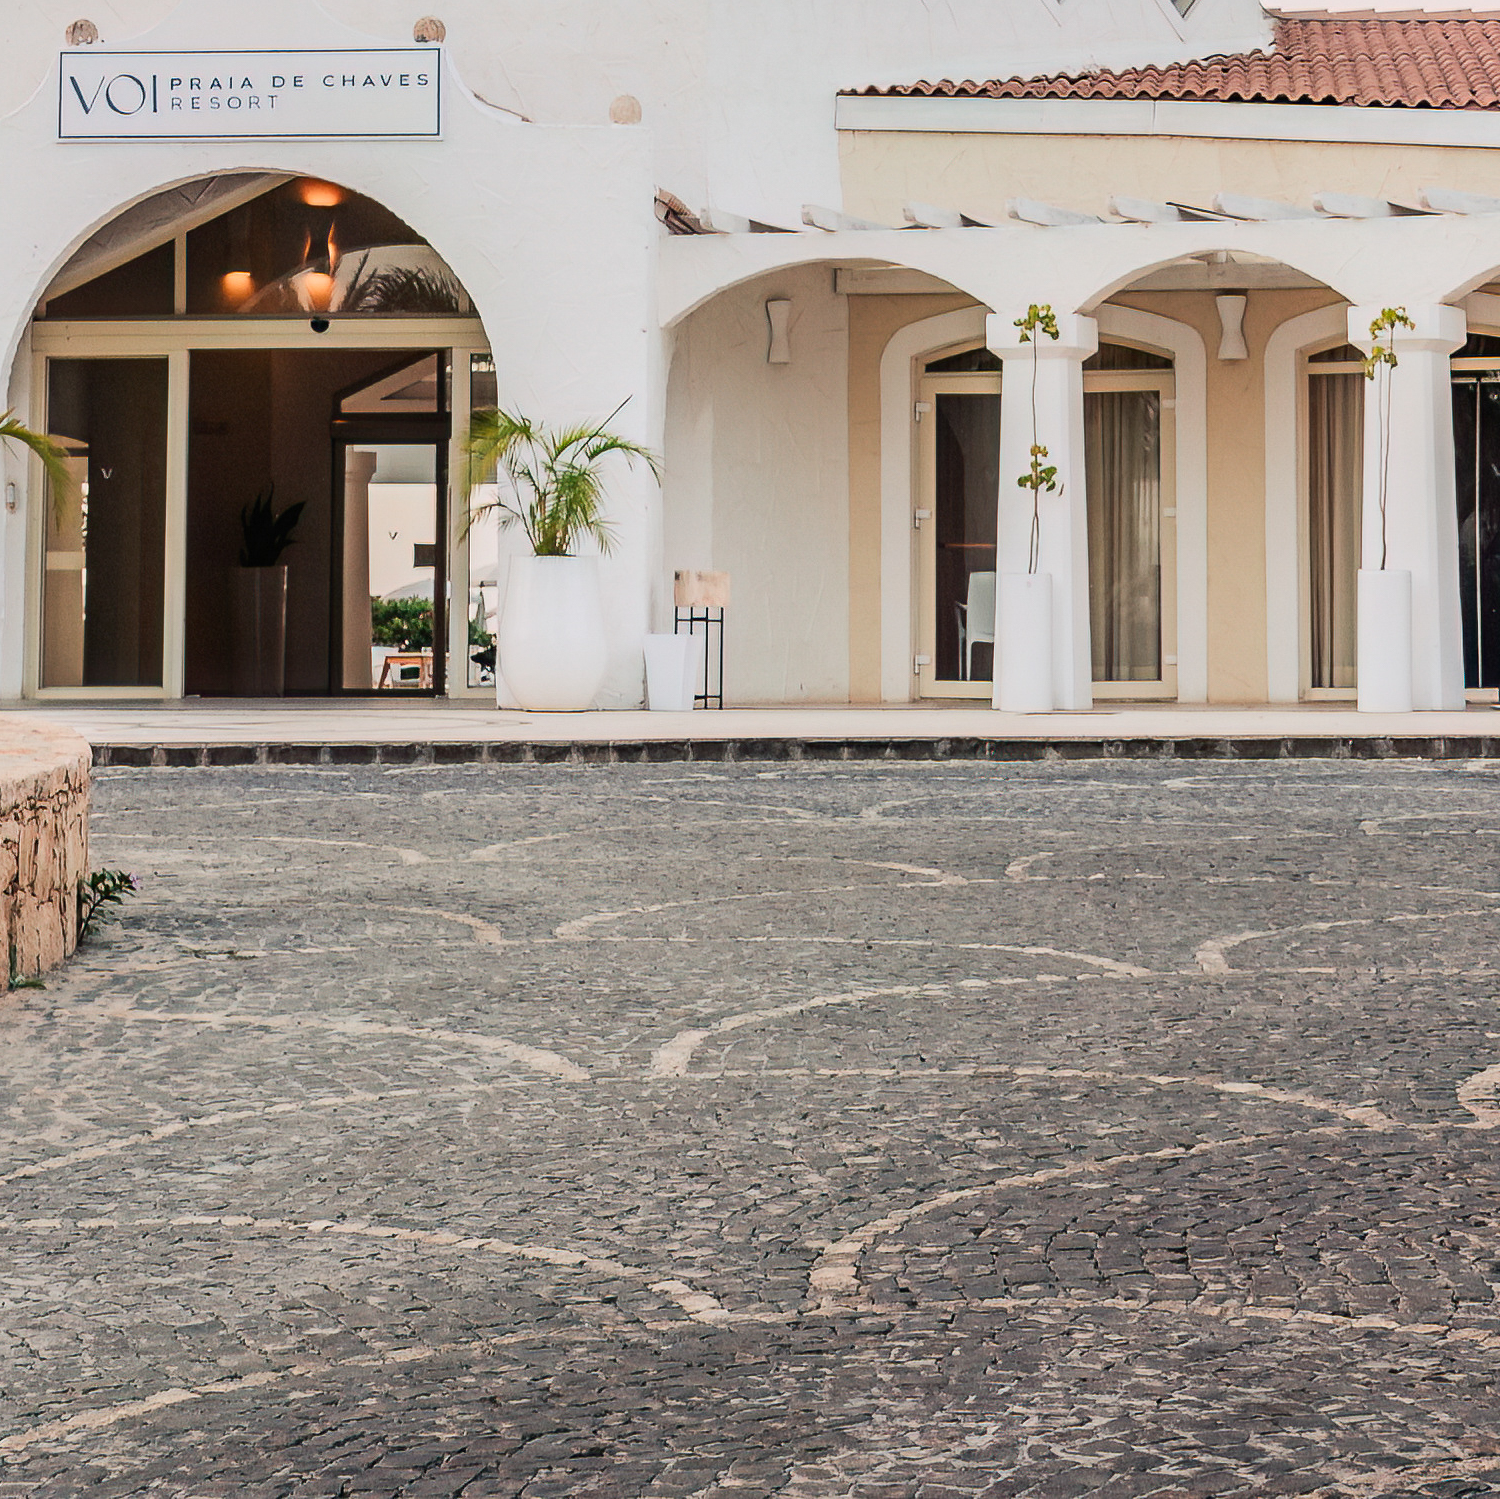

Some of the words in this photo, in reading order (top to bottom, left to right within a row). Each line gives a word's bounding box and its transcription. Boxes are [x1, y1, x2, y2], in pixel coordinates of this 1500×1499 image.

[170, 76, 254, 91] PRAIA
[271, 74, 304, 89] DE
[322, 72, 430, 88] CHAVES
[69, 73, 159, 116] VOI
[170, 94, 278, 111] RESORT
